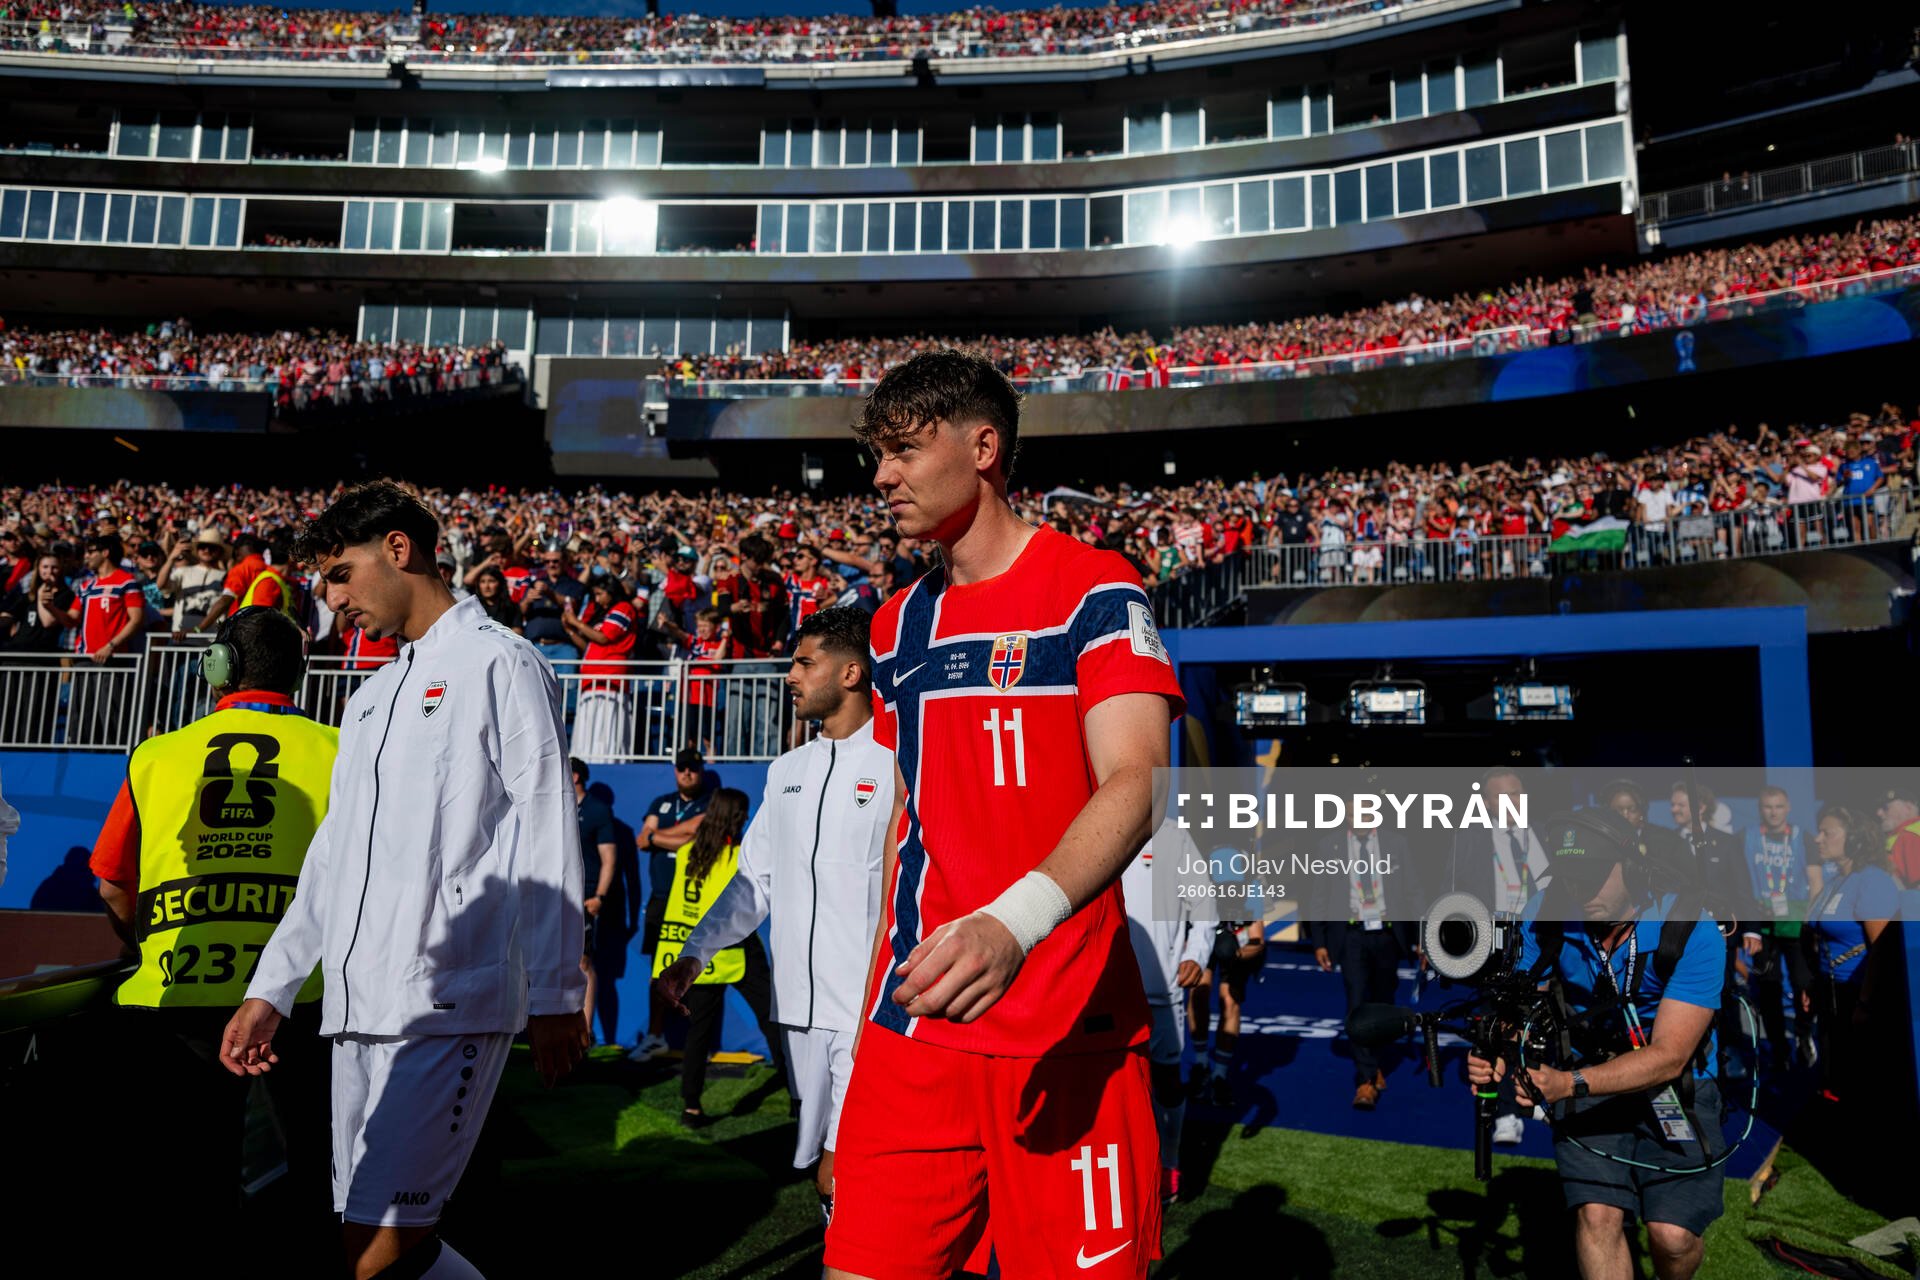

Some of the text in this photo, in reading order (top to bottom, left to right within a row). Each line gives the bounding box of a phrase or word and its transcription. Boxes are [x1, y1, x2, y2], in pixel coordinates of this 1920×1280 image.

[101, 597, 110, 613] 9
[983, 708, 1027, 787] 11
[782, 785, 802, 794] JAKO
[220, 807, 255, 819] FIFA
[198, 832, 274, 843] WORLD CUP
[197, 844, 273, 861] 2026
[151, 883, 298, 926] SECURIT
[1070, 1143, 1123, 1231] 11
[390, 1192, 431, 1206] JAKO
